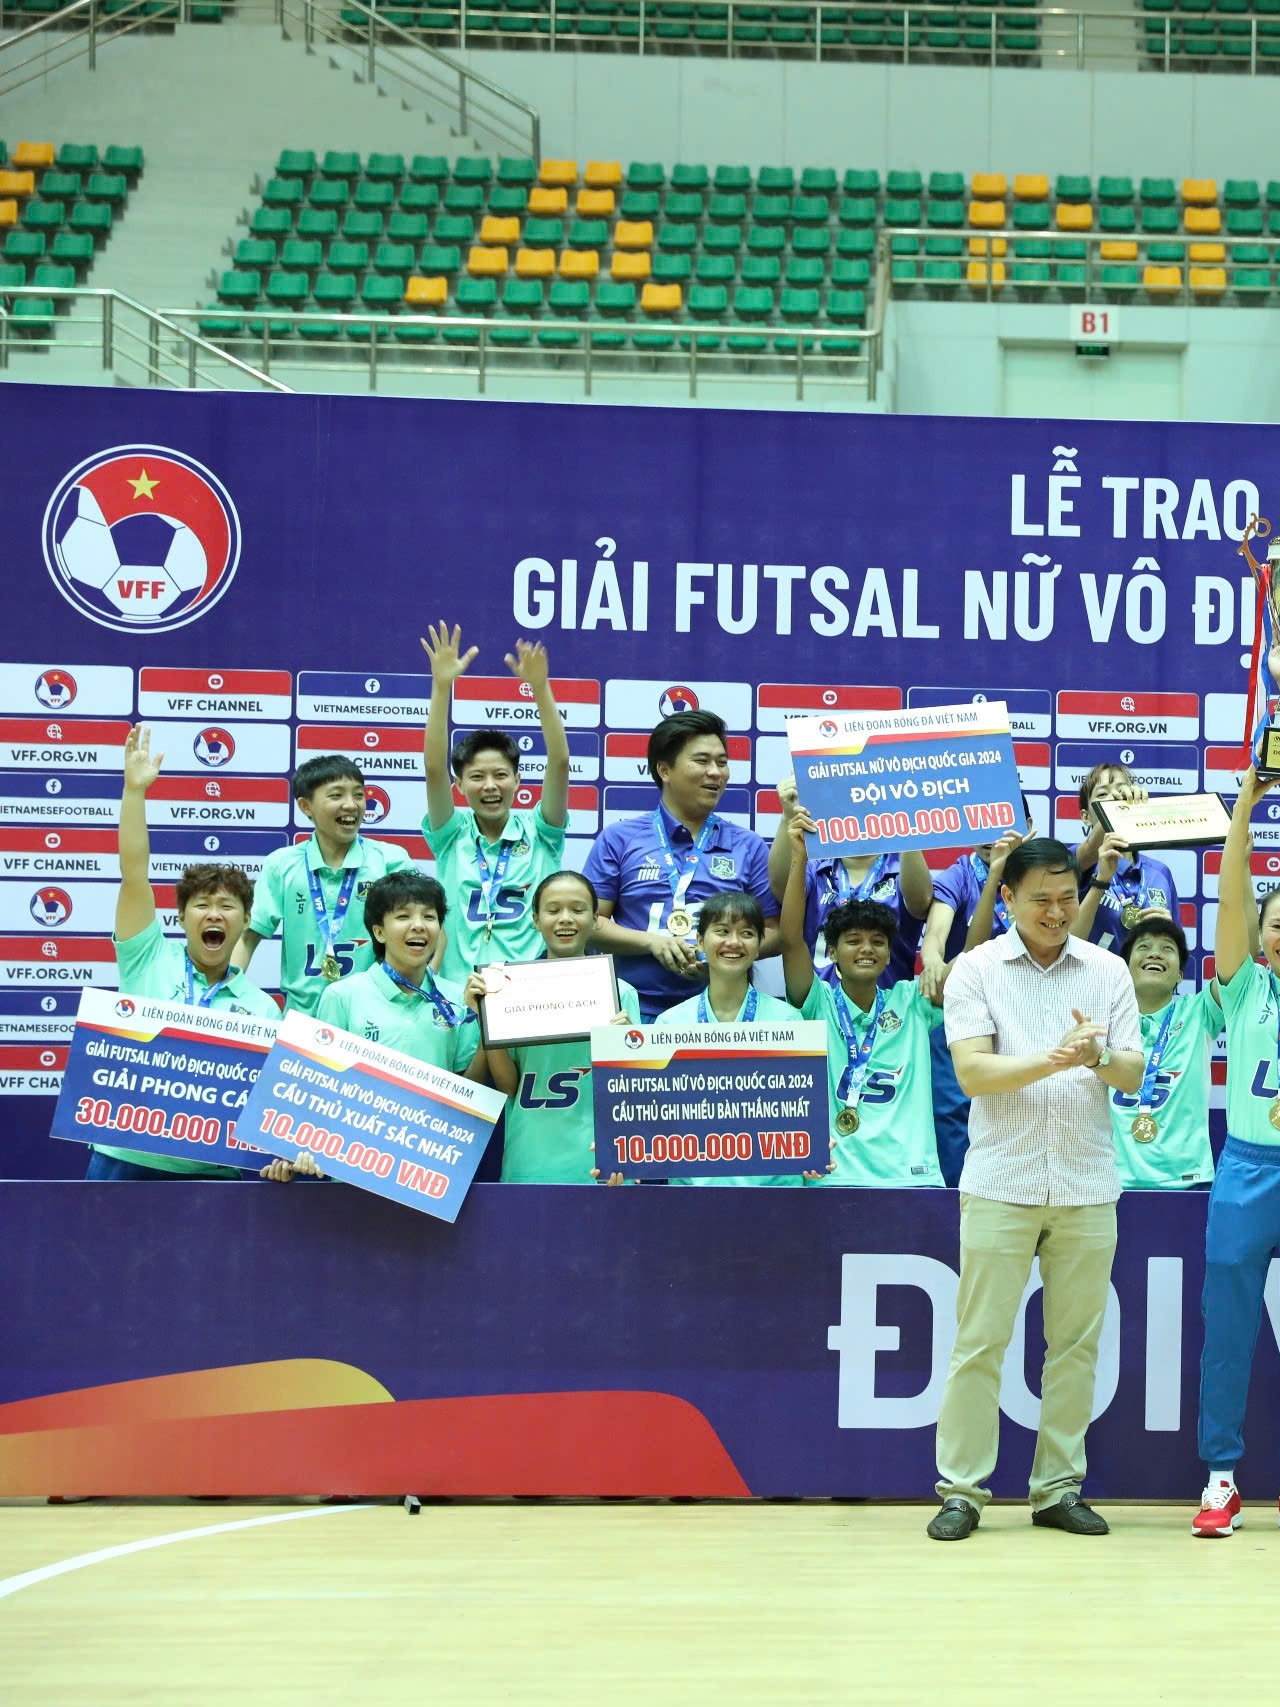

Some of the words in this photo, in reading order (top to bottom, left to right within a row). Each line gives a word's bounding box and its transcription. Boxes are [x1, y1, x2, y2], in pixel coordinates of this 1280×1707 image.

[1081, 311, 1109, 335] B1
[1011, 445, 1082, 537] LỄ
[1101, 476, 1260, 541] TRAO
[117, 580, 166, 600] VFF
[512, 537, 648, 631] GIẢI
[675, 562, 940, 639] FUTSAL
[964, 554, 1062, 642] NỮ
[1079, 556, 1167, 645] VÔ
[167, 699, 194, 711] VFF
[197, 700, 263, 712] CHANNEL
[313, 704, 430, 716] VIETNAMESEFOOTBALL
[485, 707, 567, 720] VFF.ORN
[921, 713, 934, 727] ĐÁ
[934, 712, 956, 728] VIỆT
[956, 711, 978, 724] NAM
[1088, 721, 1168, 734] VFF.ORG.VN
[11, 749, 97, 763] VFF.ORG.VN
[352, 757, 418, 770] CHANNEL
[807, 760, 830, 779] GIẢI
[830, 759, 869, 777] FUTSAL
[868, 756, 888, 774] NỮ
[887, 755, 901, 773] VÔ
[901, 755, 927, 774] ĐỊCH
[928, 749, 959, 770] QUỐC
[958, 751, 977, 767] GIA
[978, 749, 1002, 765] 2024
[850, 782, 887, 806] ĐỘI
[889, 778, 918, 800] VÔ
[921, 777, 970, 803] ĐỊCH
[0, 805, 114, 816] IETNAMESEFOOTBALL
[170, 807, 255, 820] VFF.ORG.VN
[815, 806, 960, 845] 100.000.000
[963, 801, 1015, 831] VNĐ
[3, 858, 29, 871] VFF
[33, 858, 101, 872] CHANNEL
[314, 897, 324, 912] VFF
[466, 889, 526, 922] LS
[304, 943, 355, 977] LS
[6, 967, 93, 980] VFF.ORG.VN
[141, 1005, 164, 1020] LIÊN
[166, 1007, 194, 1025] ĐOÀN
[195, 1012, 223, 1030] BÓNG
[225, 1017, 239, 1033] ĐÁ
[240, 1021, 262, 1039] VIỆT
[263, 1026, 278, 1038] NA
[651, 1030, 672, 1045] LIÊN
[674, 1029, 702, 1044] ĐOÀN
[704, 1029, 732, 1044] BÓNG
[733, 1029, 747, 1043] ĐÁ
[749, 1029, 770, 1045] VIỆT
[771, 1030, 795, 1042] NAM
[86, 1039, 110, 1058] GIẢI
[110, 1044, 150, 1066] FUTSAL
[152, 1050, 171, 1067] NỮ
[171, 1053, 187, 1071] VÔ
[187, 1059, 215, 1078] ĐỊCH
[215, 1057, 248, 1082] QUỐC
[849, 1043, 858, 1059] VFF
[1152, 1052, 1161, 1067] VFF
[0, 1077, 26, 1088] VFF
[92, 1067, 138, 1091] GIẢI
[140, 1076, 217, 1105] PHONG
[221, 1084, 249, 1109] CÁ
[416, 1066, 430, 1082] ĐÁ
[431, 1072, 452, 1092] VIỆT
[451, 1082, 475, 1100] NAM
[519, 1071, 581, 1110] LS
[607, 1073, 630, 1093] GIẢI
[631, 1076, 671, 1093] FUTSAL
[672, 1073, 691, 1092] NỮ
[690, 1073, 705, 1091] VÔ
[706, 1075, 734, 1095] ĐỊCH
[735, 1070, 766, 1092] QUỐC
[767, 1074, 787, 1090] GIA
[788, 1074, 814, 1089] 2024
[835, 1065, 897, 1104] LS
[279, 1058, 302, 1078] GIẢI
[301, 1066, 340, 1093] FUTSAL
[340, 1079, 360, 1099] NỮ
[358, 1085, 373, 1105] VÔ
[371, 1096, 400, 1117] ĐỊCH
[400, 1103, 431, 1126] QUỐC
[429, 1117, 449, 1134] GIA
[448, 1124, 476, 1145] 2024
[612, 1099, 635, 1123] CẦU
[635, 1098, 659, 1122] THỦ
[660, 1103, 680, 1121] GHI
[681, 1097, 715, 1121] NHIỀU
[717, 1100, 741, 1119] BÀN
[741, 1097, 779, 1118] THẮNG
[781, 1096, 811, 1118] NHẤT
[74, 1096, 221, 1145] 30.000.000
[308, 1093, 343, 1120] THỦ
[341, 1103, 387, 1138] XUẤT
[383, 1122, 418, 1150] SẮC
[416, 1136, 463, 1167] NHẤT
[259, 1108, 396, 1178] 10.000.000
[396, 1159, 450, 1200] VNĐ
[613, 1132, 753, 1163] 10.000.000
[757, 1130, 811, 1160] VNĐ
